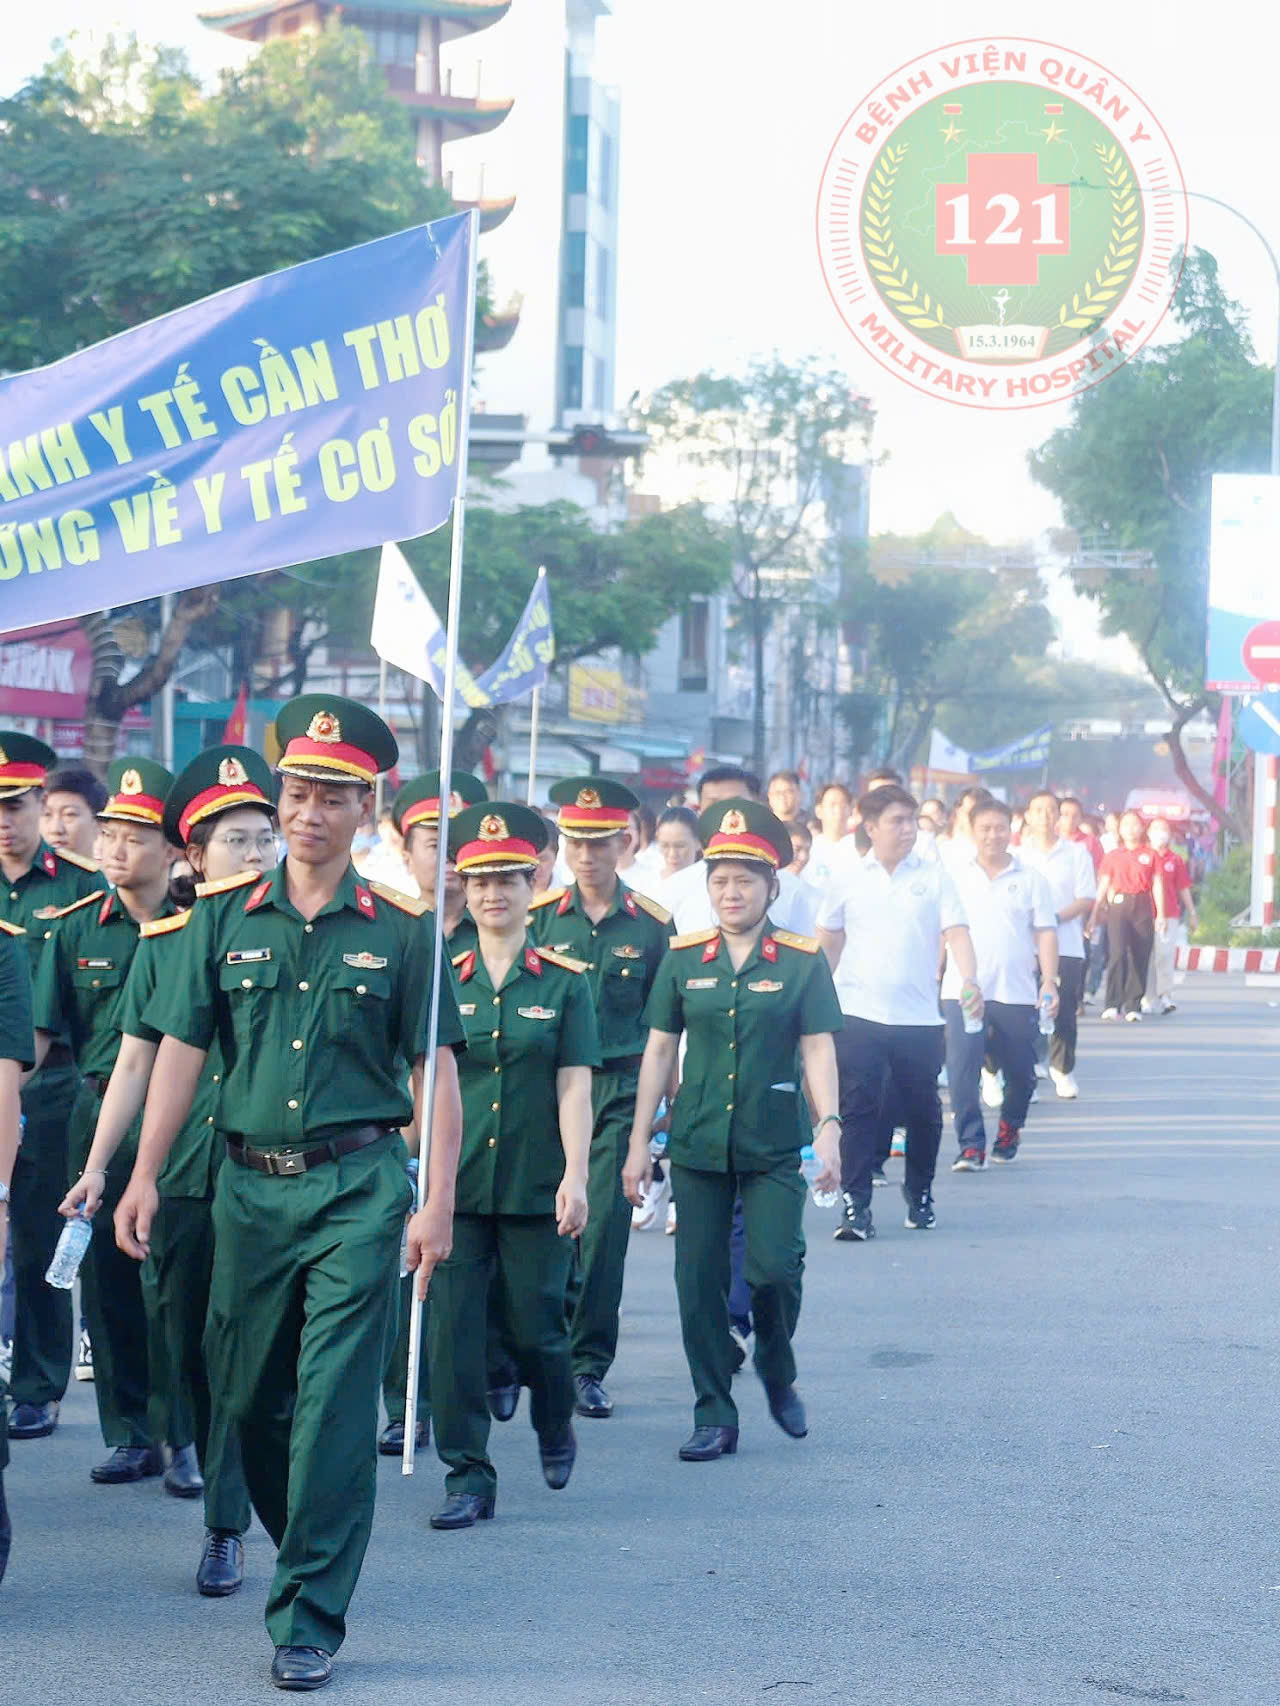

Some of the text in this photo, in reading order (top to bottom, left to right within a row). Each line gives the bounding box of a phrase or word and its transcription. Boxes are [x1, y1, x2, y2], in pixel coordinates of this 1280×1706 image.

[88, 405, 133, 464] Y
[139, 362, 218, 449] TẾ
[220, 336, 339, 426] CẦN
[343, 293, 451, 390] THƠ
[110, 468, 183, 553] VỀ
[193, 472, 229, 534] Y
[240, 431, 308, 522] TẾ
[318, 417, 397, 502] CƠ
[408, 388, 457, 478] SỞ
